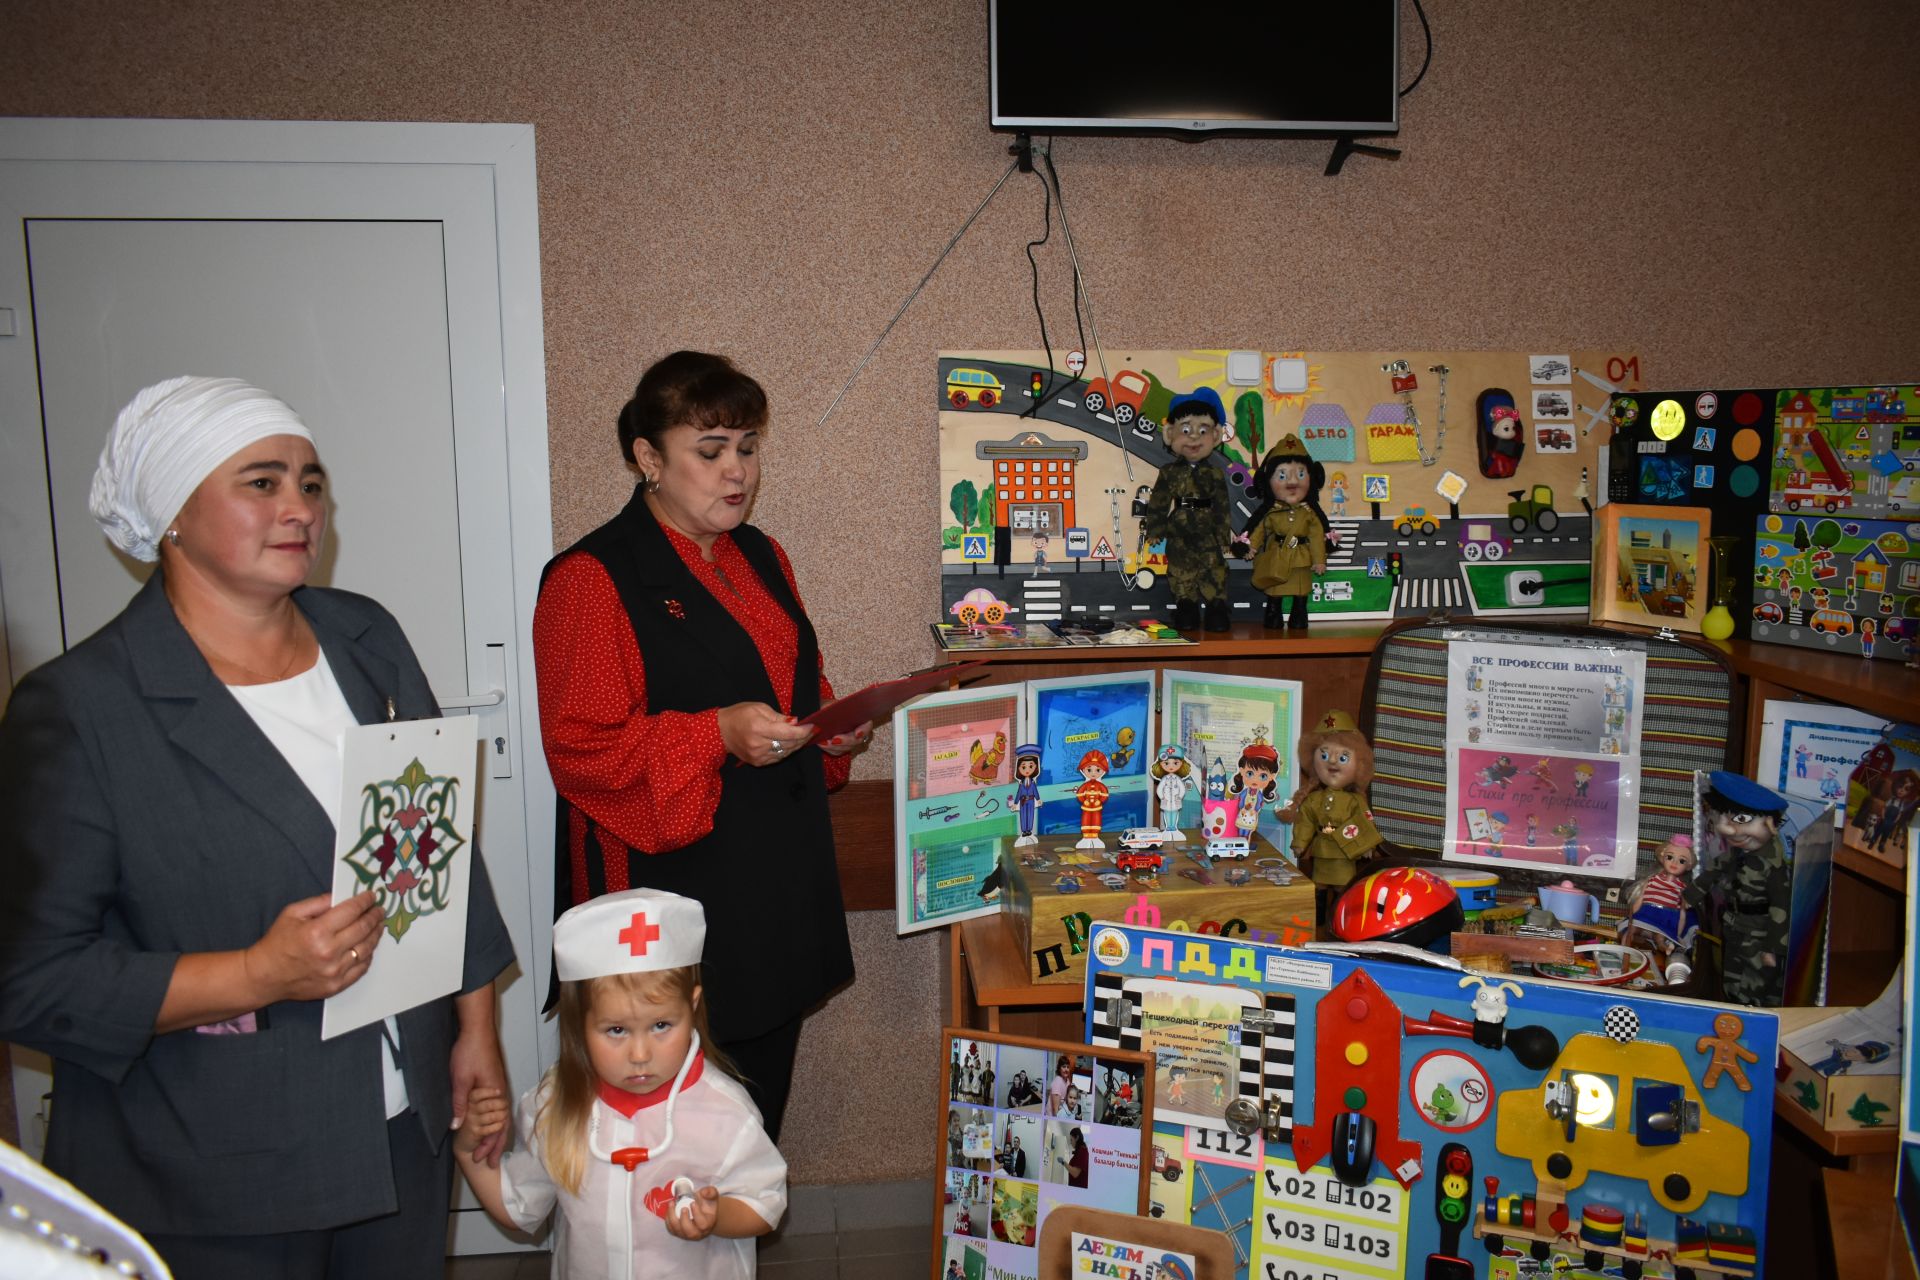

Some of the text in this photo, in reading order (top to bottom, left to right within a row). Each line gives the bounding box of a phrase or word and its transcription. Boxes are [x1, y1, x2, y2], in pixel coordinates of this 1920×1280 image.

[1607, 356, 1639, 382] 01
[1304, 428, 1347, 439] ДЕПО
[1370, 426, 1415, 438] ГАРАЖ
[1472, 656, 1622, 674] ВСЕ ПРОФЕССИИ ВАЖНЫ!
[1489, 680, 1527, 689] Профессий
[1066, 733, 1099, 742] РАСКРАСКИ
[1468, 783, 1609, 814] Стихи про профессии
[1142, 937, 1262, 982] ПДД
[1141, 1011, 1240, 1032] Пешеходный переход
[1165, 1032, 1198, 1041] подземный
[1201, 1037, 1228, 1047] переход,
[1092, 1147, 1113, 1157] Кошман
[1197, 1128, 1252, 1158] 112
[1094, 1157, 1139, 1170] балалар бакчасы
[1285, 1177, 1392, 1214] 02 102
[1285, 1221, 1390, 1258] 03 103
[1078, 1238, 1144, 1264] ДЕТЯМ
[1079, 1257, 1141, 1280] ЗНАТЬ
